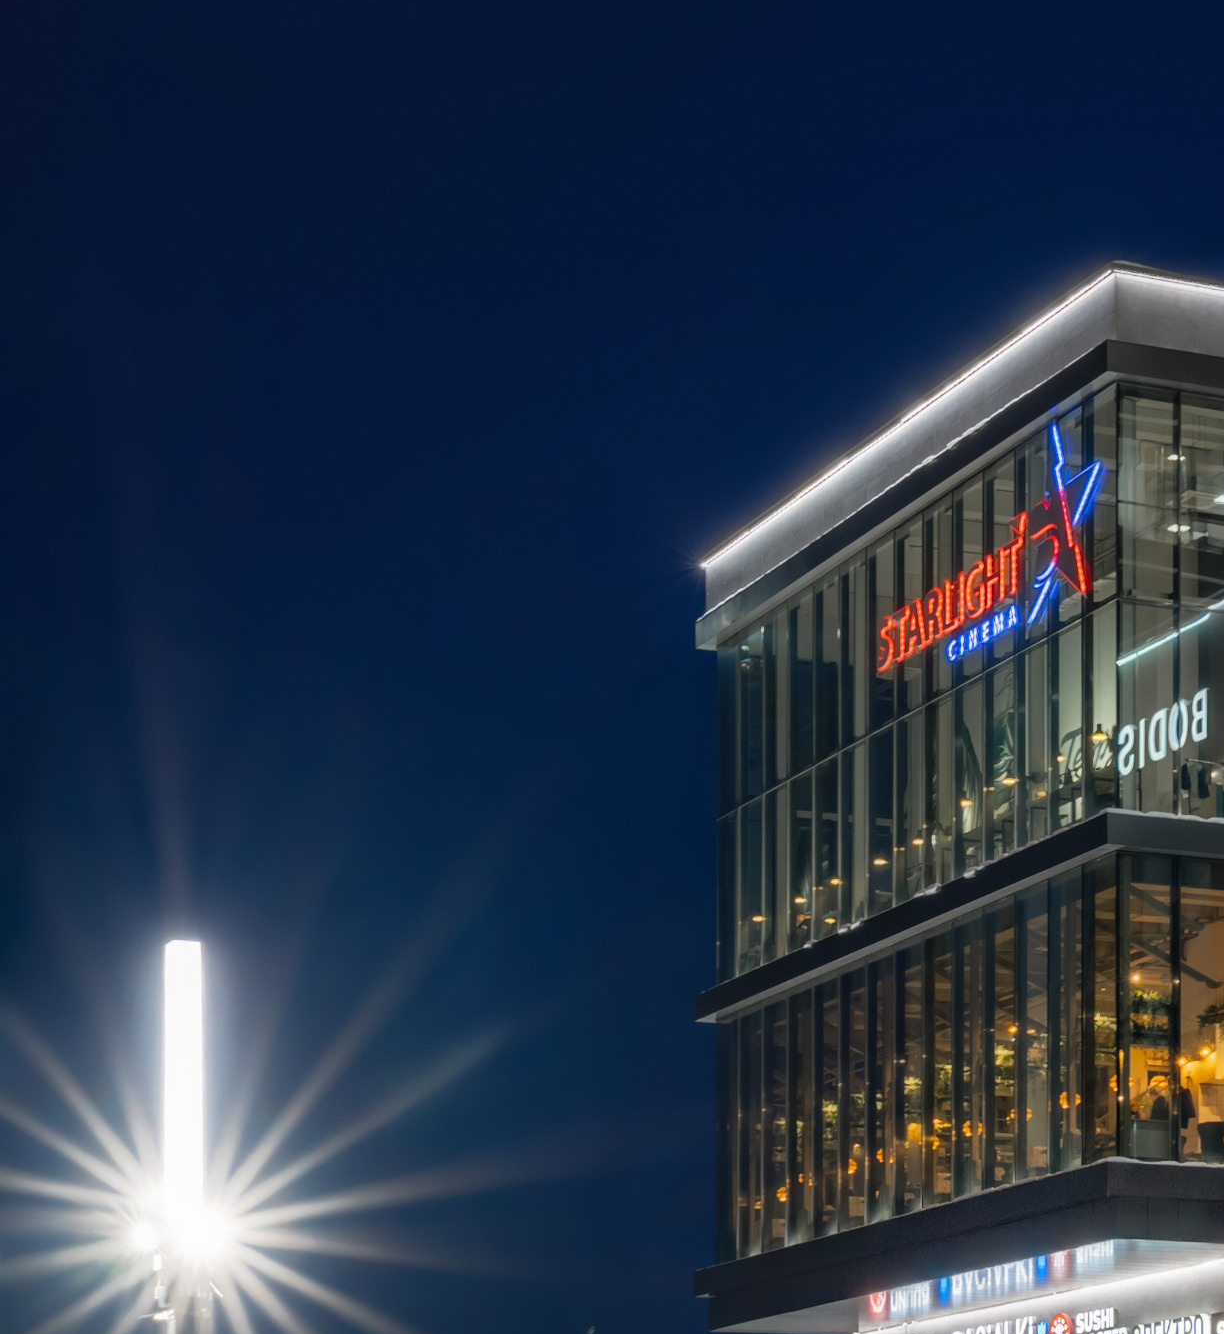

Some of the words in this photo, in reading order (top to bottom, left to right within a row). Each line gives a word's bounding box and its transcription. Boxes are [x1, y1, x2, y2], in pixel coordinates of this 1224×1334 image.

[877, 533, 1026, 673] STARLIGHT
[946, 603, 1019, 663] CINEMA
[1075, 1307, 1115, 1333] SUSHI
